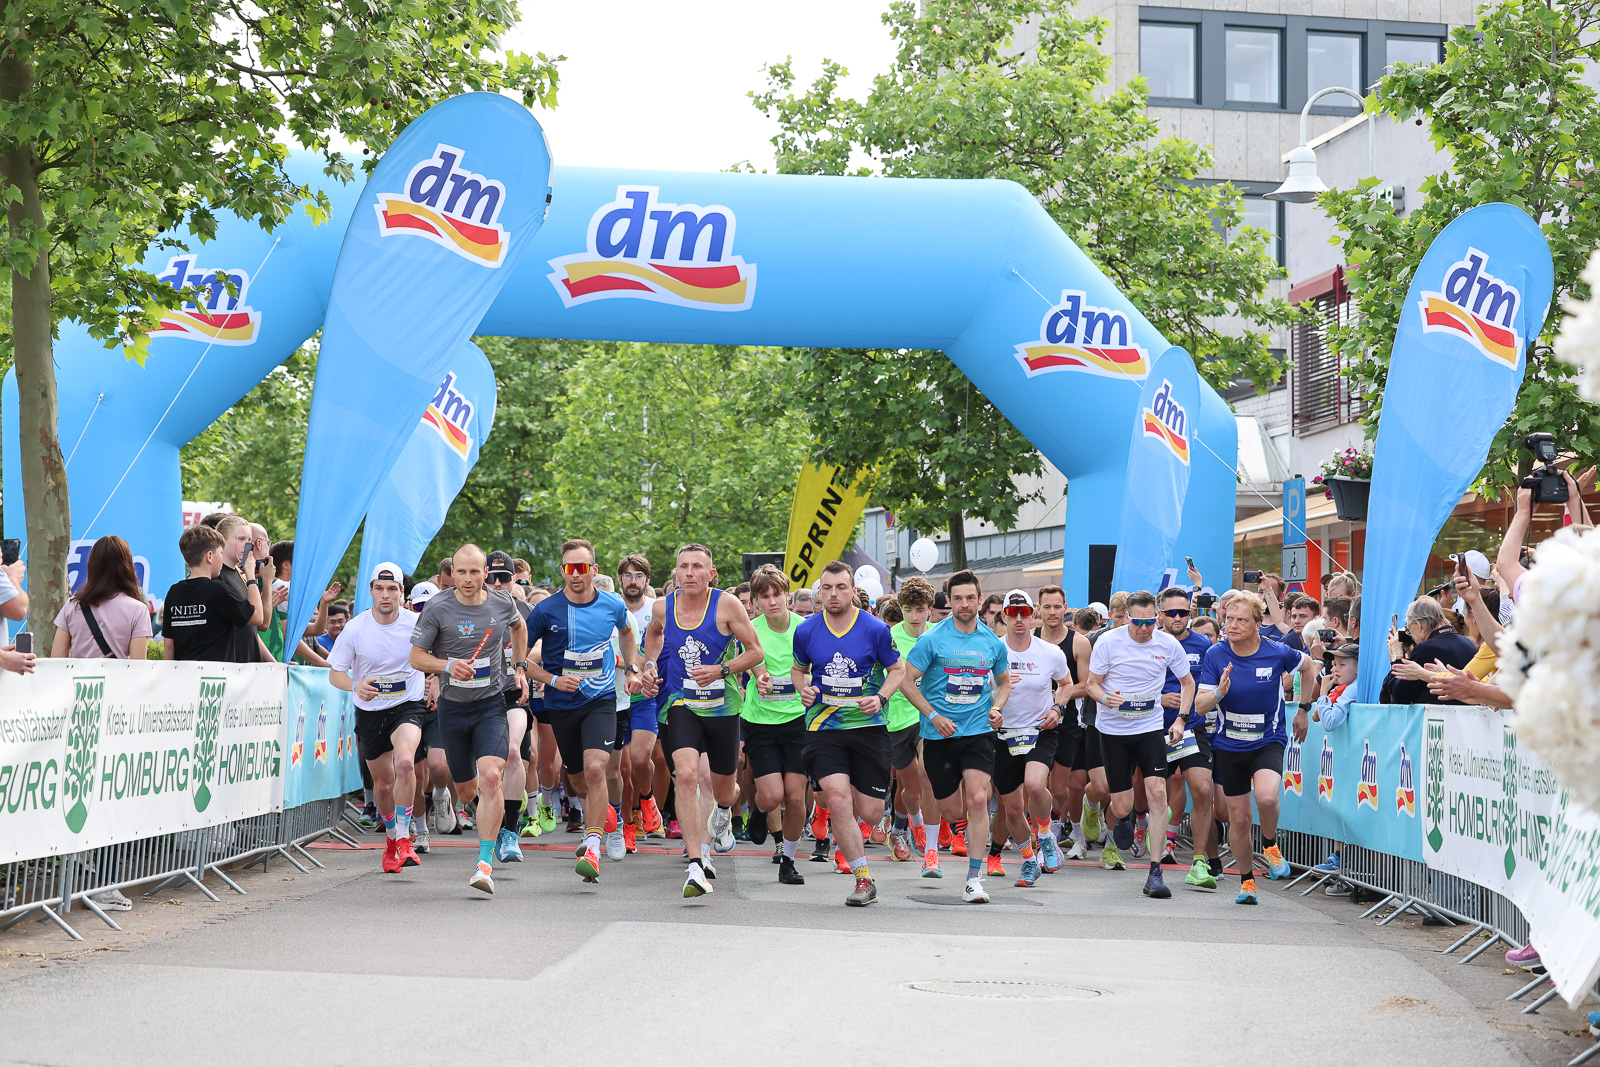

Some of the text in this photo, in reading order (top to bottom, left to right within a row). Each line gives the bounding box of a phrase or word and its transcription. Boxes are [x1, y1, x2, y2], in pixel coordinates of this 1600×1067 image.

[410, 151, 500, 225] dm
[596, 191, 727, 262] dm
[1445, 254, 1516, 328] dm
[1046, 295, 1127, 346] dm
[1153, 383, 1185, 435] dm
[1288, 488, 1300, 537] P
[830, 686, 852, 694] Jeremy
[106, 704, 128, 736] Kreis-
[1232, 721, 1257, 729] Matthias
[100, 747, 190, 802] HOMBURG
[218, 739, 281, 786] HOMBURG
[1287, 736, 1301, 773] dm
[1320, 738, 1334, 778] dm
[1361, 742, 1377, 784] dm
[1400, 746, 1413, 789] dm
